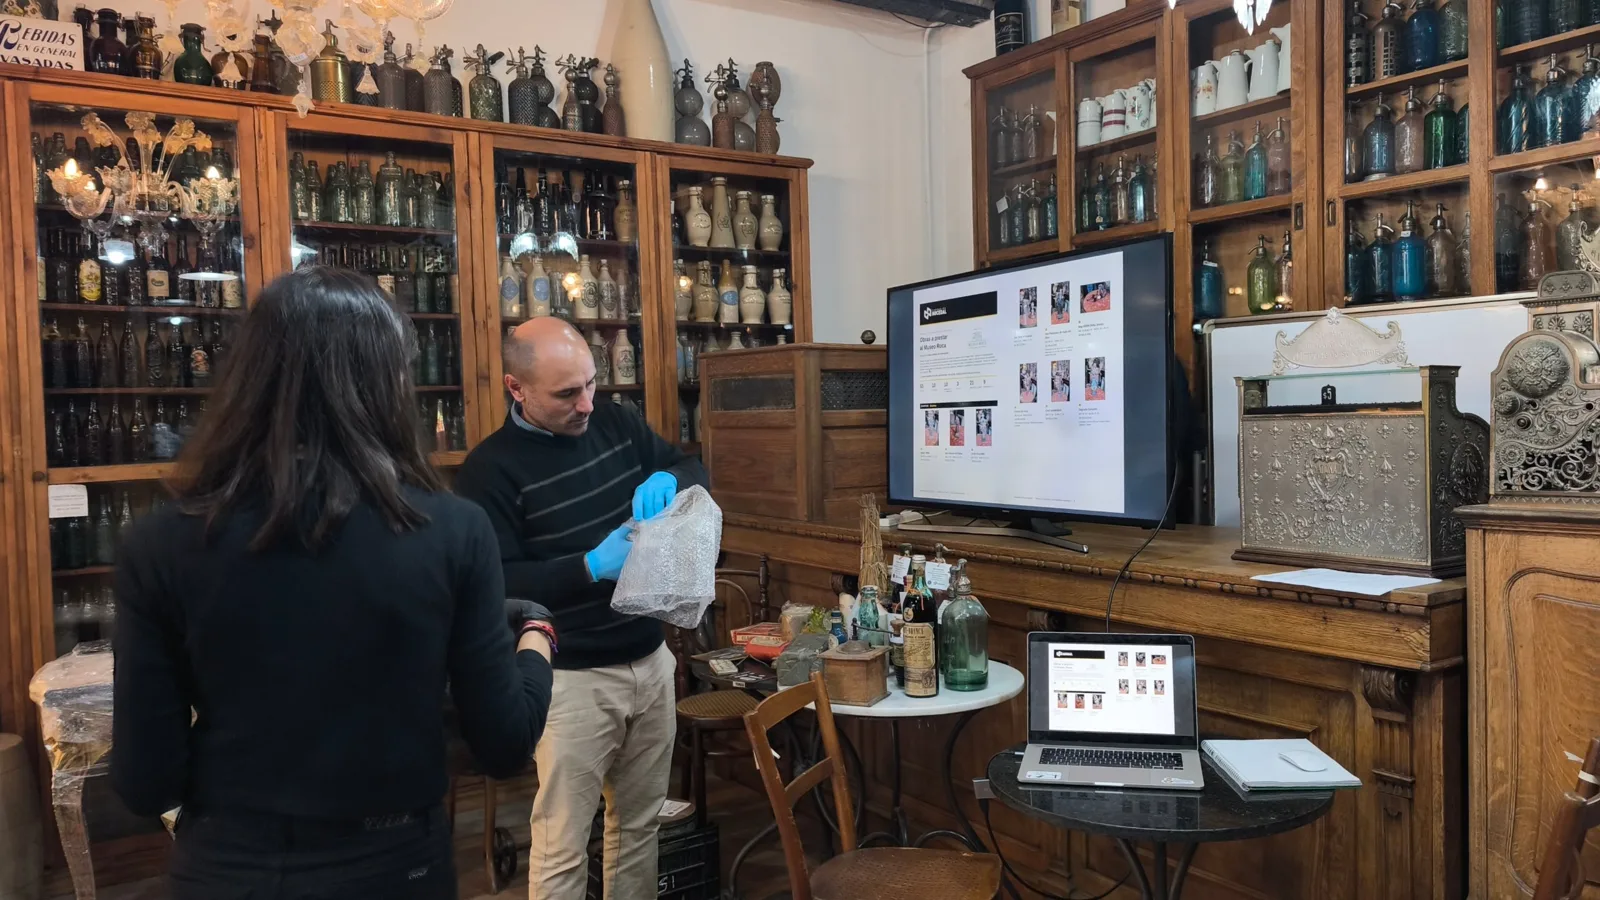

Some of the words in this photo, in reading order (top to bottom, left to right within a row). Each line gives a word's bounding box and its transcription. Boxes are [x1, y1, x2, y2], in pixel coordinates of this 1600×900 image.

[0, 18, 76, 50] BEBIDAS
[16, 43, 30, 52] EN
[33, 45, 77, 59] GENERAL
[1323, 387, 1332, 400] $5
